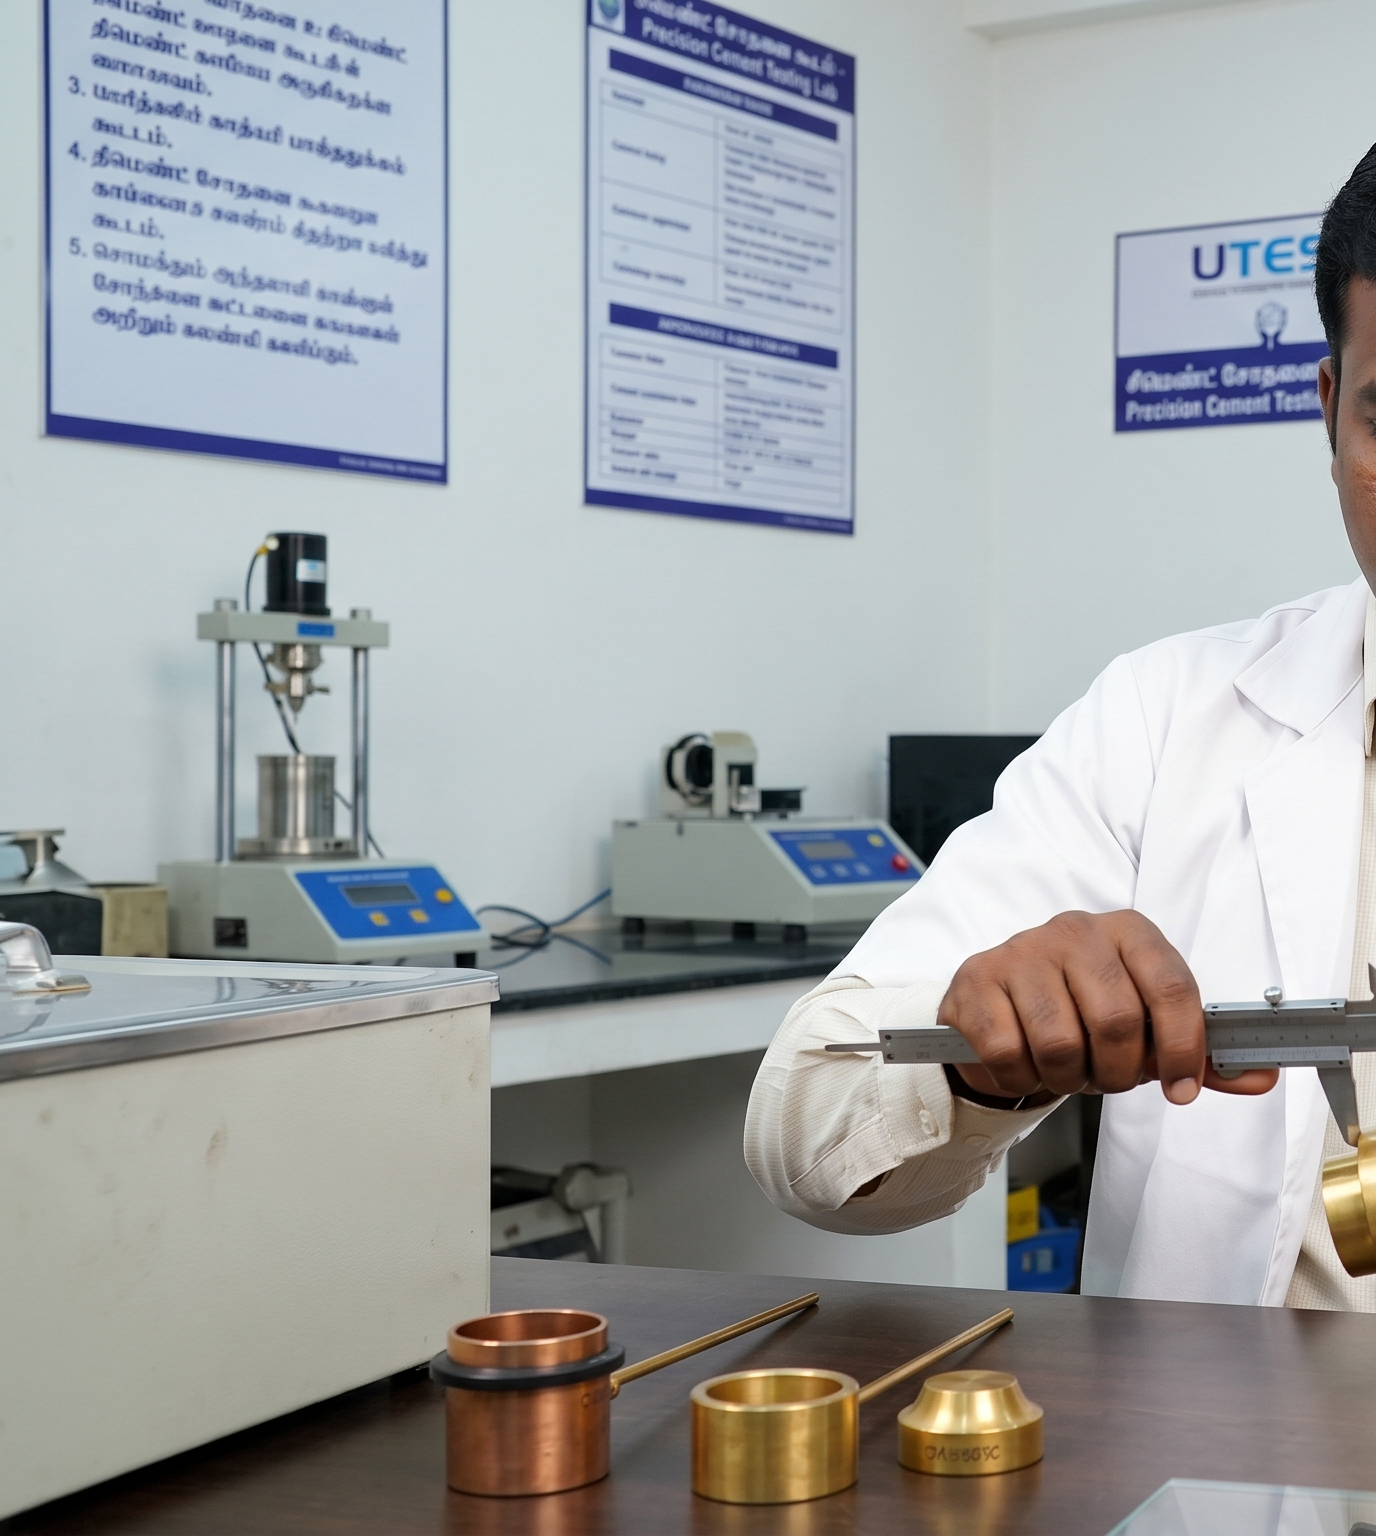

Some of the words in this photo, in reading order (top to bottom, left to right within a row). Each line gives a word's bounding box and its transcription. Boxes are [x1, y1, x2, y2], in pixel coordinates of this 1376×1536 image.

[641, 16, 709, 58] Precision
[710, 40, 764, 77] Cement
[765, 59, 812, 98] Testing
[813, 76, 839, 103] Lab
[69, 75, 85, 96] 3.
[68, 141, 86, 161] 4.
[70, 237, 86, 256] 5.
[1125, 396, 1203, 423] Precision
[1205, 391, 1272, 418] Cement
